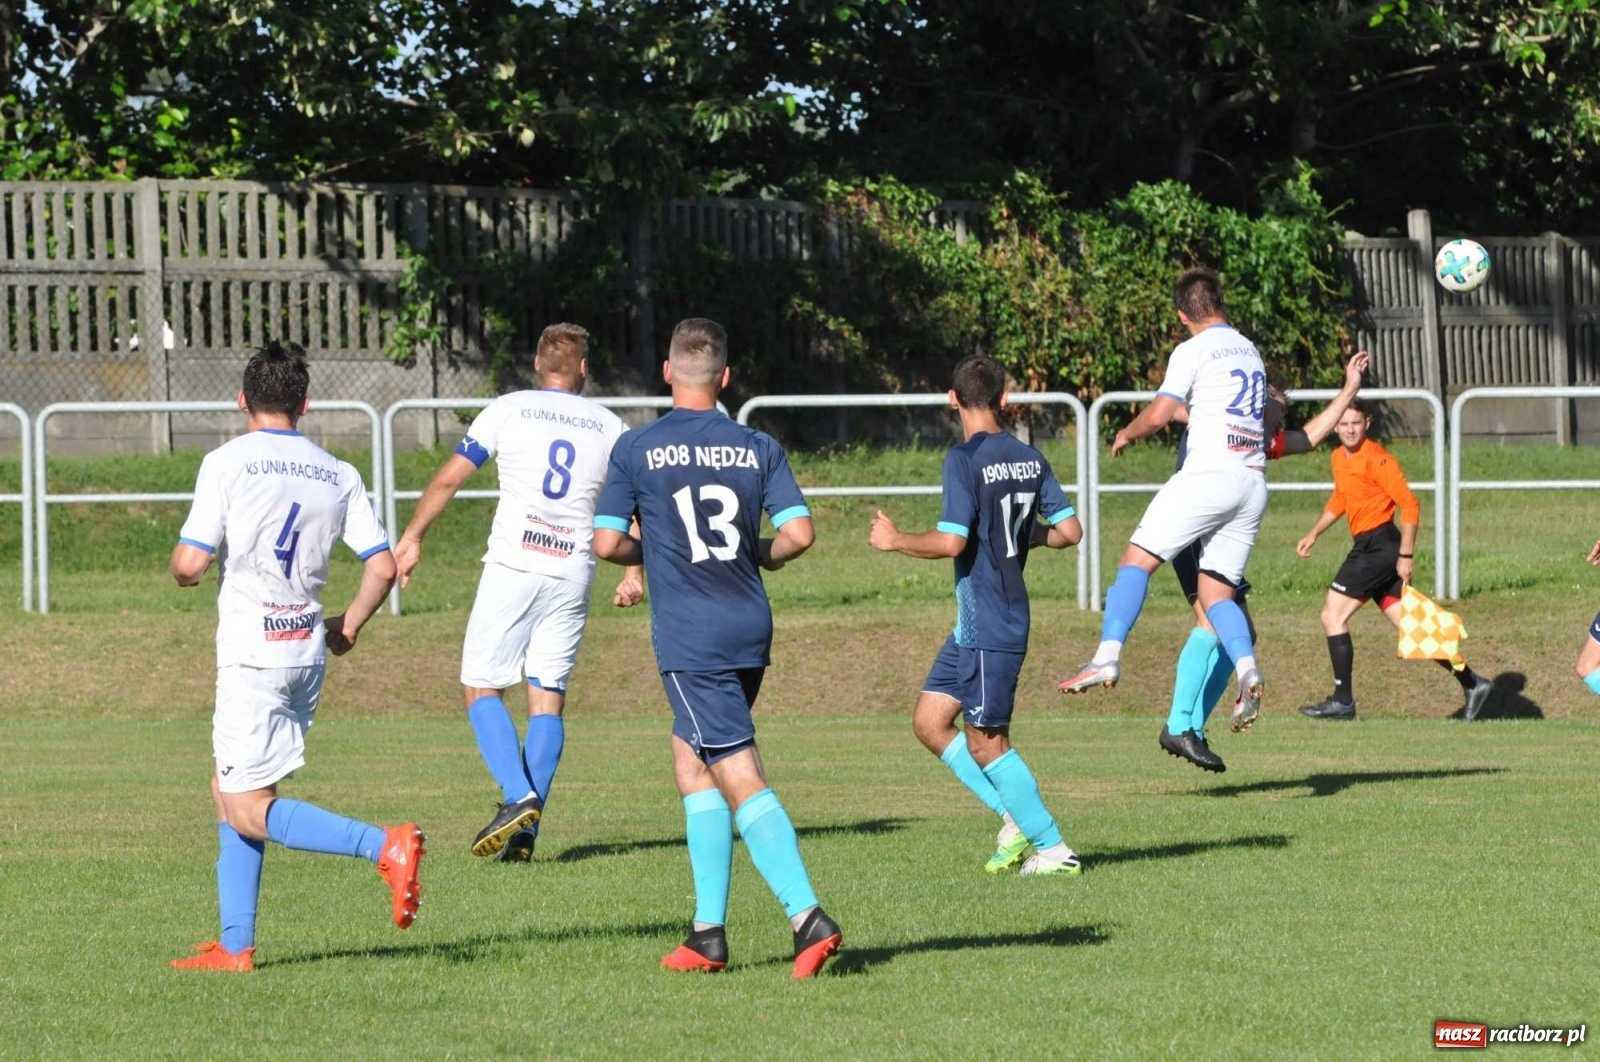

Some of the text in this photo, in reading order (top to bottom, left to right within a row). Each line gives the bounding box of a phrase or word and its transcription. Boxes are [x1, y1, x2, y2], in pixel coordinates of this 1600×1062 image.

[1225, 368, 1265, 420] 20
[521, 408, 532, 420] KS
[533, 409, 558, 423] UNIA
[246, 459, 339, 487] KS UNIA RACIBÓRZ
[542, 439, 576, 500] 8
[645, 444, 759, 471] 1908 NĘDZA
[982, 462, 1010, 485] 1908
[273, 501, 302, 580] 4
[522, 530, 576, 556] nowiny
[671, 484, 741, 564] 13
[1000, 492, 1036, 558] 17
